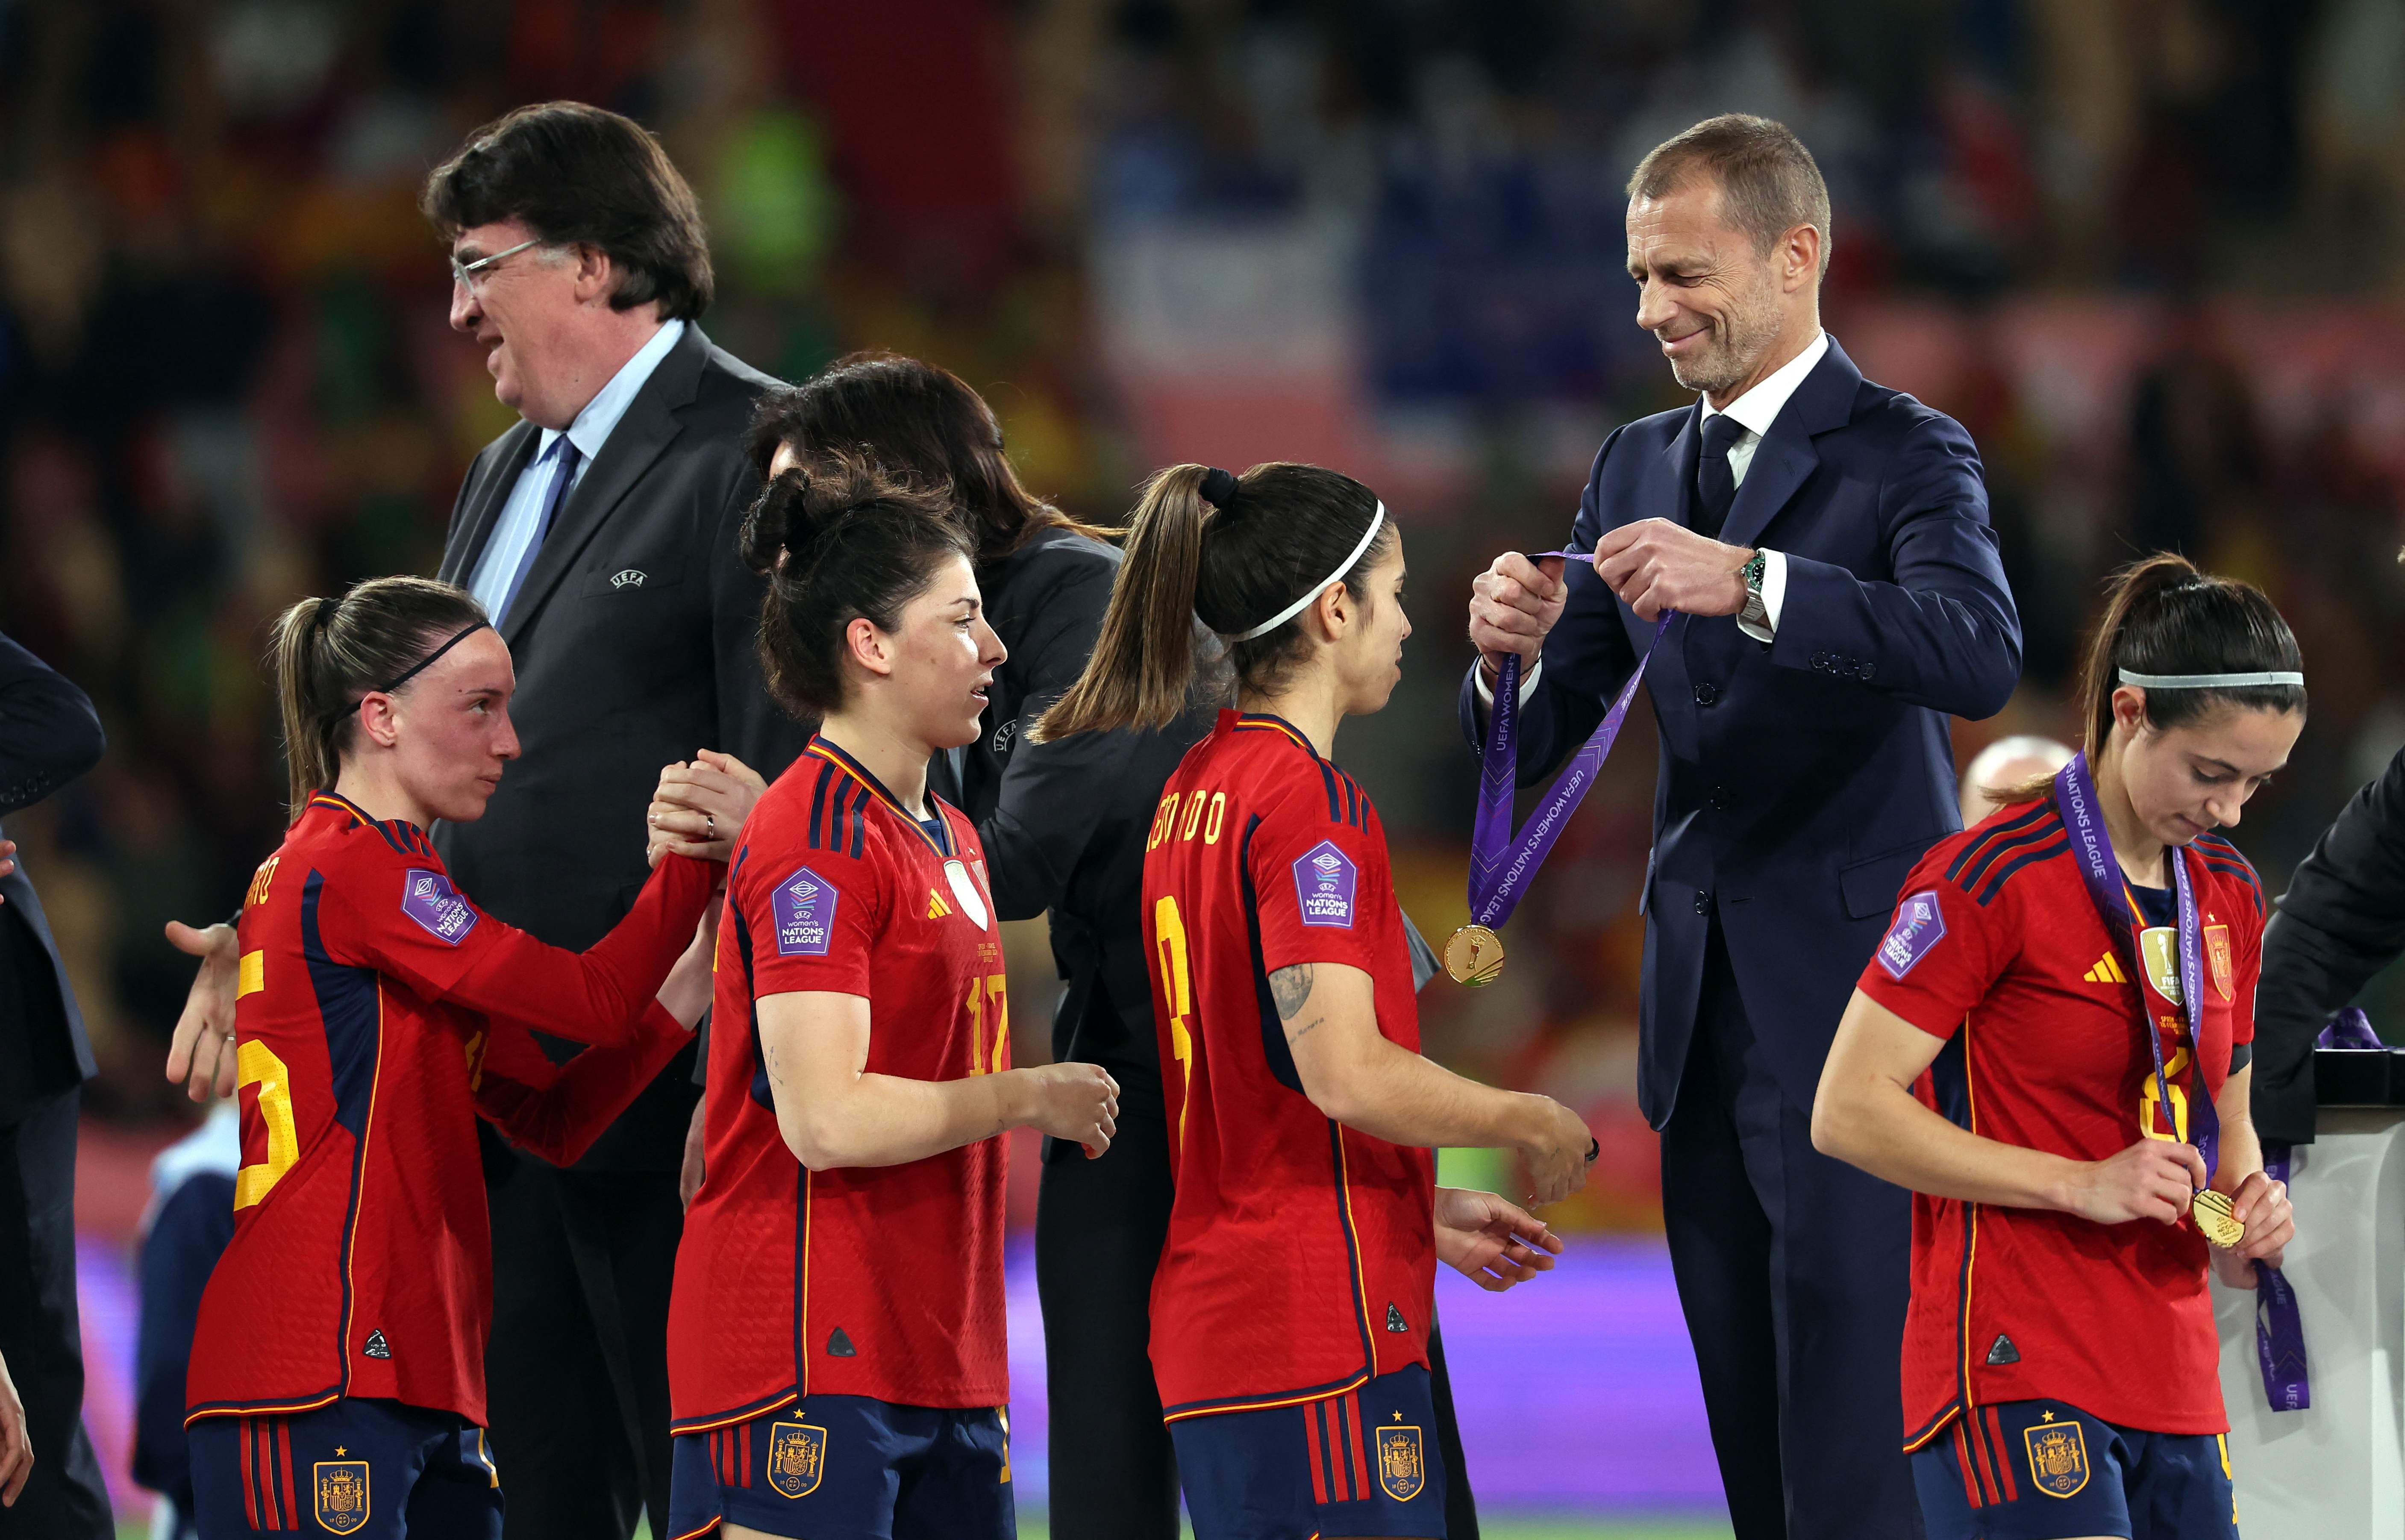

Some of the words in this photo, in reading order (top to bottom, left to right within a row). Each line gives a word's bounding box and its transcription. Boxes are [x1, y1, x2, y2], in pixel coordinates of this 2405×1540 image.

[611, 572, 644, 587] UEFA
[996, 722, 1016, 751] UEFA
[1497, 718, 1510, 751] UEFA
[1562, 770, 1585, 798] UEFA
[2066, 776, 2090, 828] NATIONS
[1528, 797, 1567, 849] WOMEN'S
[1497, 846, 1533, 896] NATIONS
[1319, 883, 1335, 891] UEFA
[436, 899, 448, 912] UEFA
[436, 900, 457, 923] women's
[436, 902, 464, 933] NATIONS
[1306, 899, 1348, 909] NATIONS
[1309, 907, 1346, 917] LEAGUE
[444, 909, 469, 936] LEAGUE
[782, 927, 824, 936] NATIONS
[2185, 899, 2193, 960] NATIONS
[785, 935, 821, 944] LEAGUE
[1888, 935, 1912, 962] NATIONS
[1885, 943, 1906, 969] LEAGUE
[2161, 976, 2180, 986] FIFA
[966, 974, 1008, 1078] 17
[1155, 896, 1192, 1155] 9
[2140, 1046, 2189, 1144] 6
